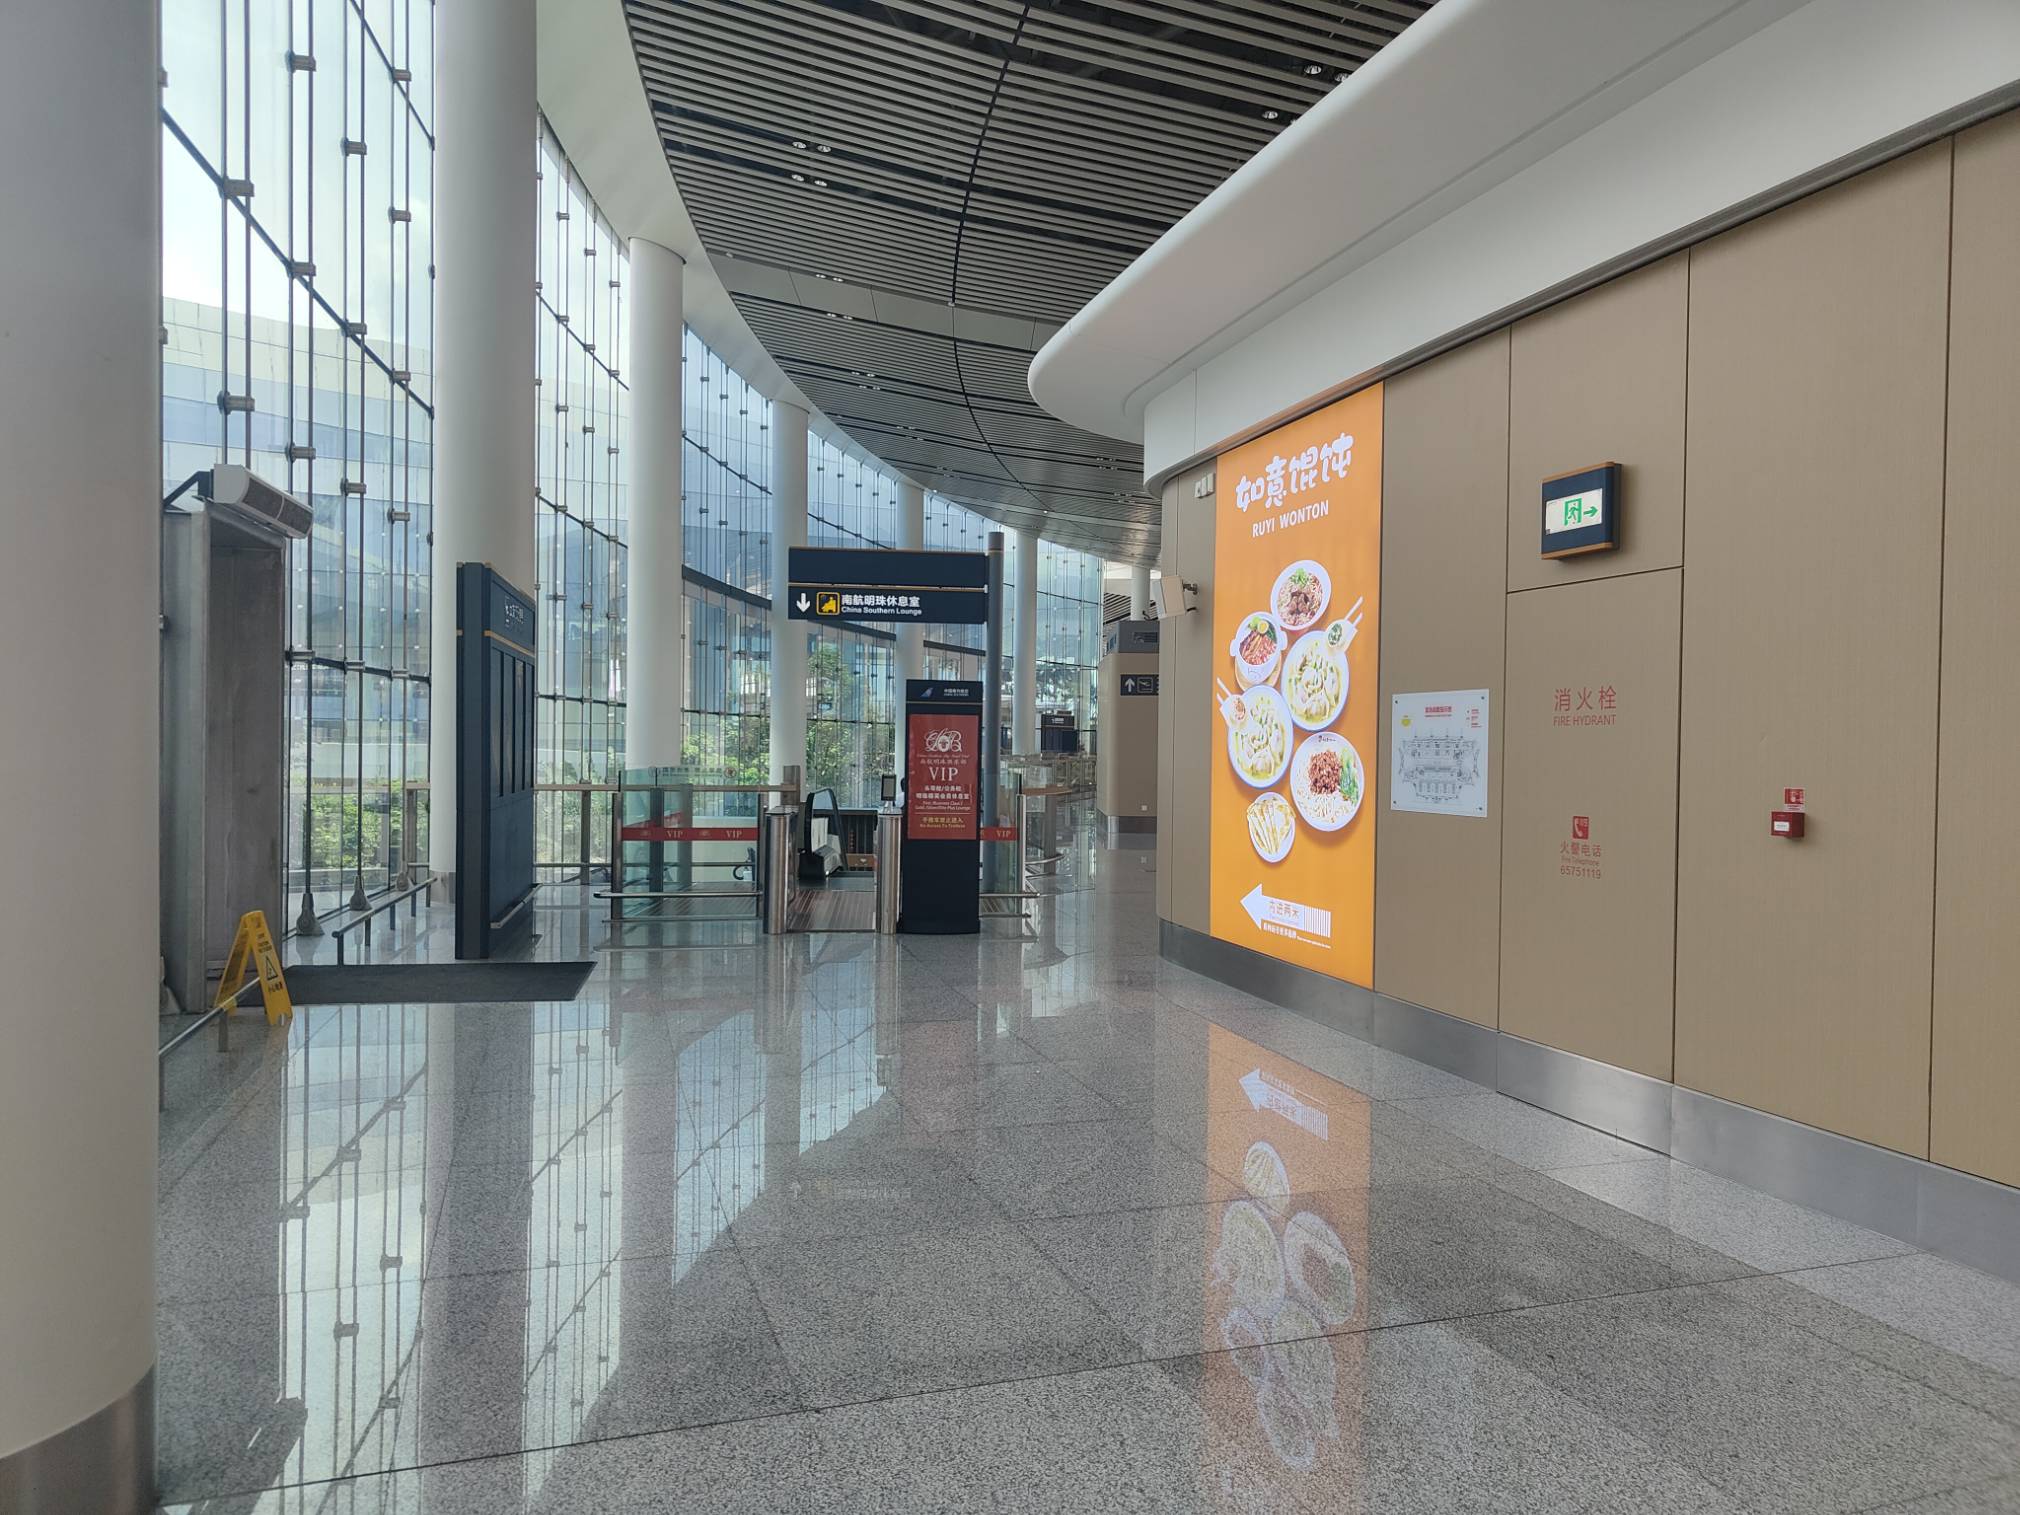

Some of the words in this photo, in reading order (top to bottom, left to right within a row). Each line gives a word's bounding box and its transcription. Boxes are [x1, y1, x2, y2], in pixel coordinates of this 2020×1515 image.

[1235, 432, 1354, 512] 如意馄饨
[1252, 518, 1275, 538] RUYI
[1280, 500, 1329, 529] WONTON
[841, 594, 920, 608] 南航明珠休息室
[896, 608, 922, 616] Lounge
[1553, 685, 1617, 712] 消火栓
[1553, 715, 1571, 727] FIRE
[1573, 714, 1616, 727] HYDRANT
[929, 766, 959, 782] VIP
[666, 830, 683, 838] VIP
[725, 830, 743, 838] VIP
[996, 829, 1011, 838] VIP
[1560, 840, 1601, 858] 火警电话
[1560, 864, 1601, 880] 65751119
